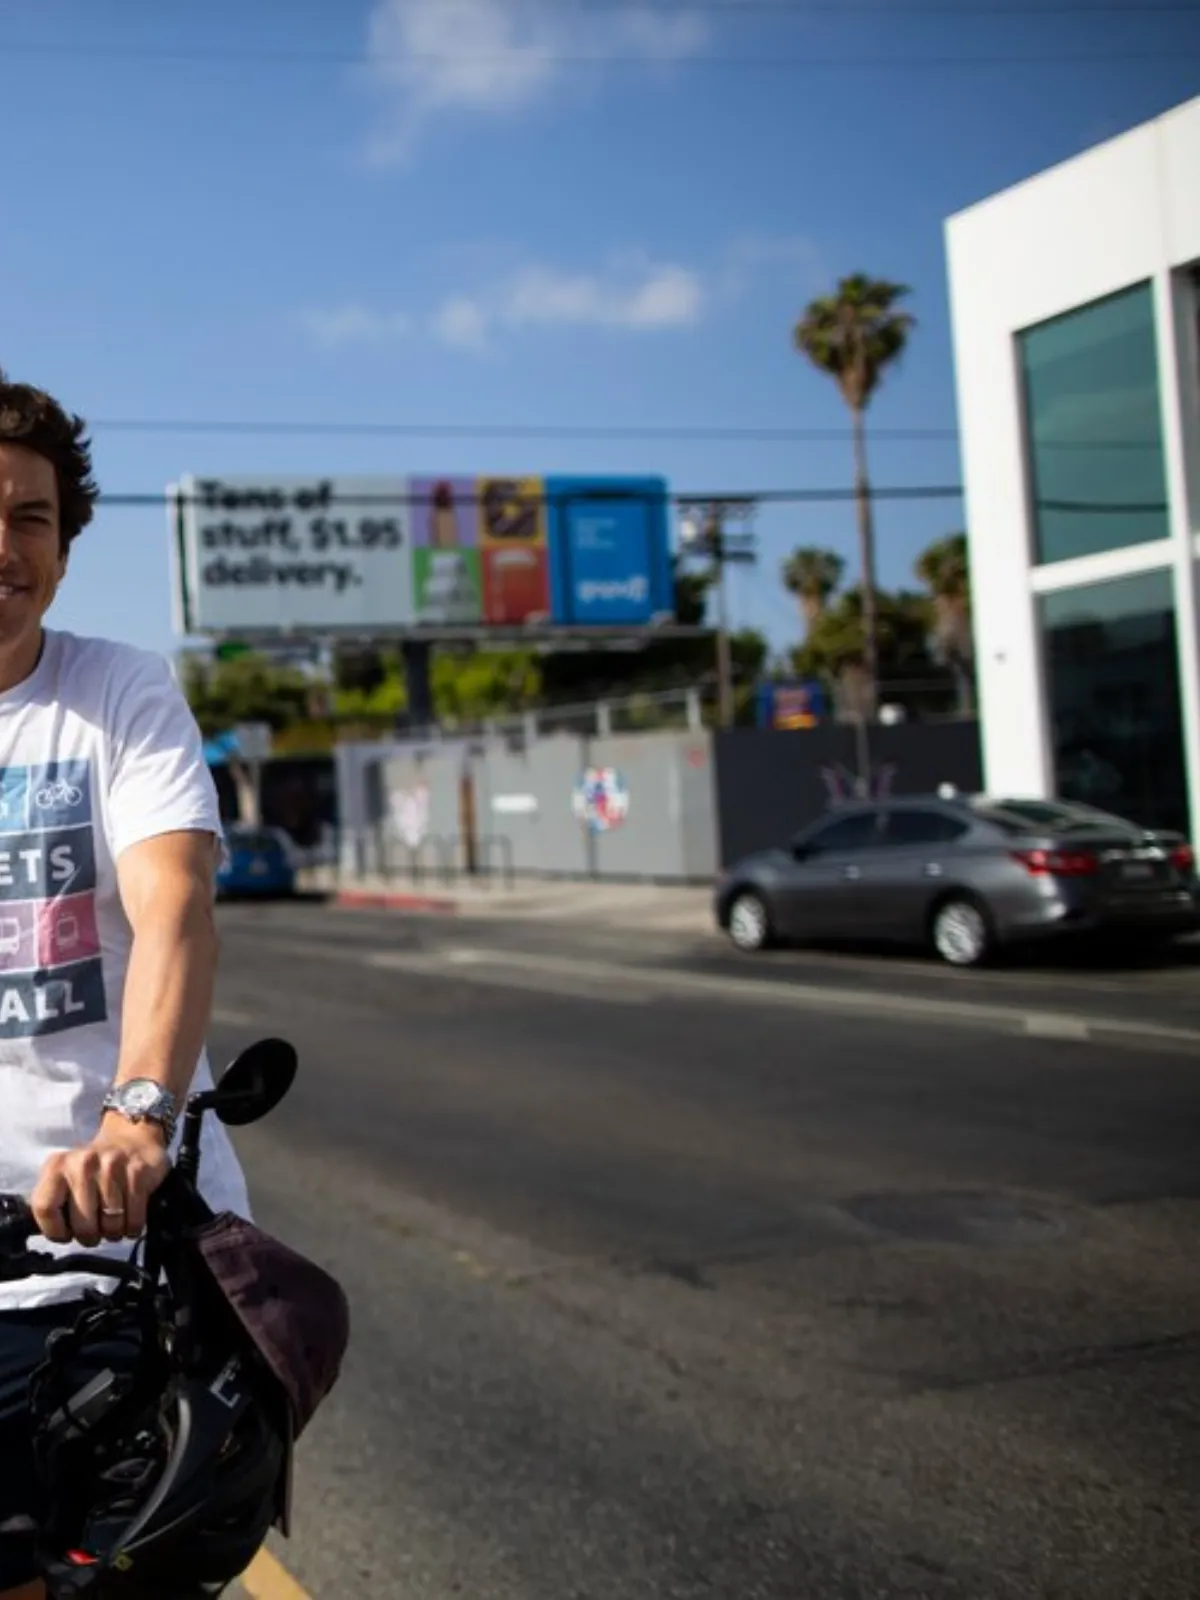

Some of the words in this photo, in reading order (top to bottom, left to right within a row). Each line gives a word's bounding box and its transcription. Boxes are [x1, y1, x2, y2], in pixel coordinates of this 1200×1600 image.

[294, 479, 332, 511] of
[202, 518, 299, 554] stuff,
[204, 556, 363, 595] delivery.
